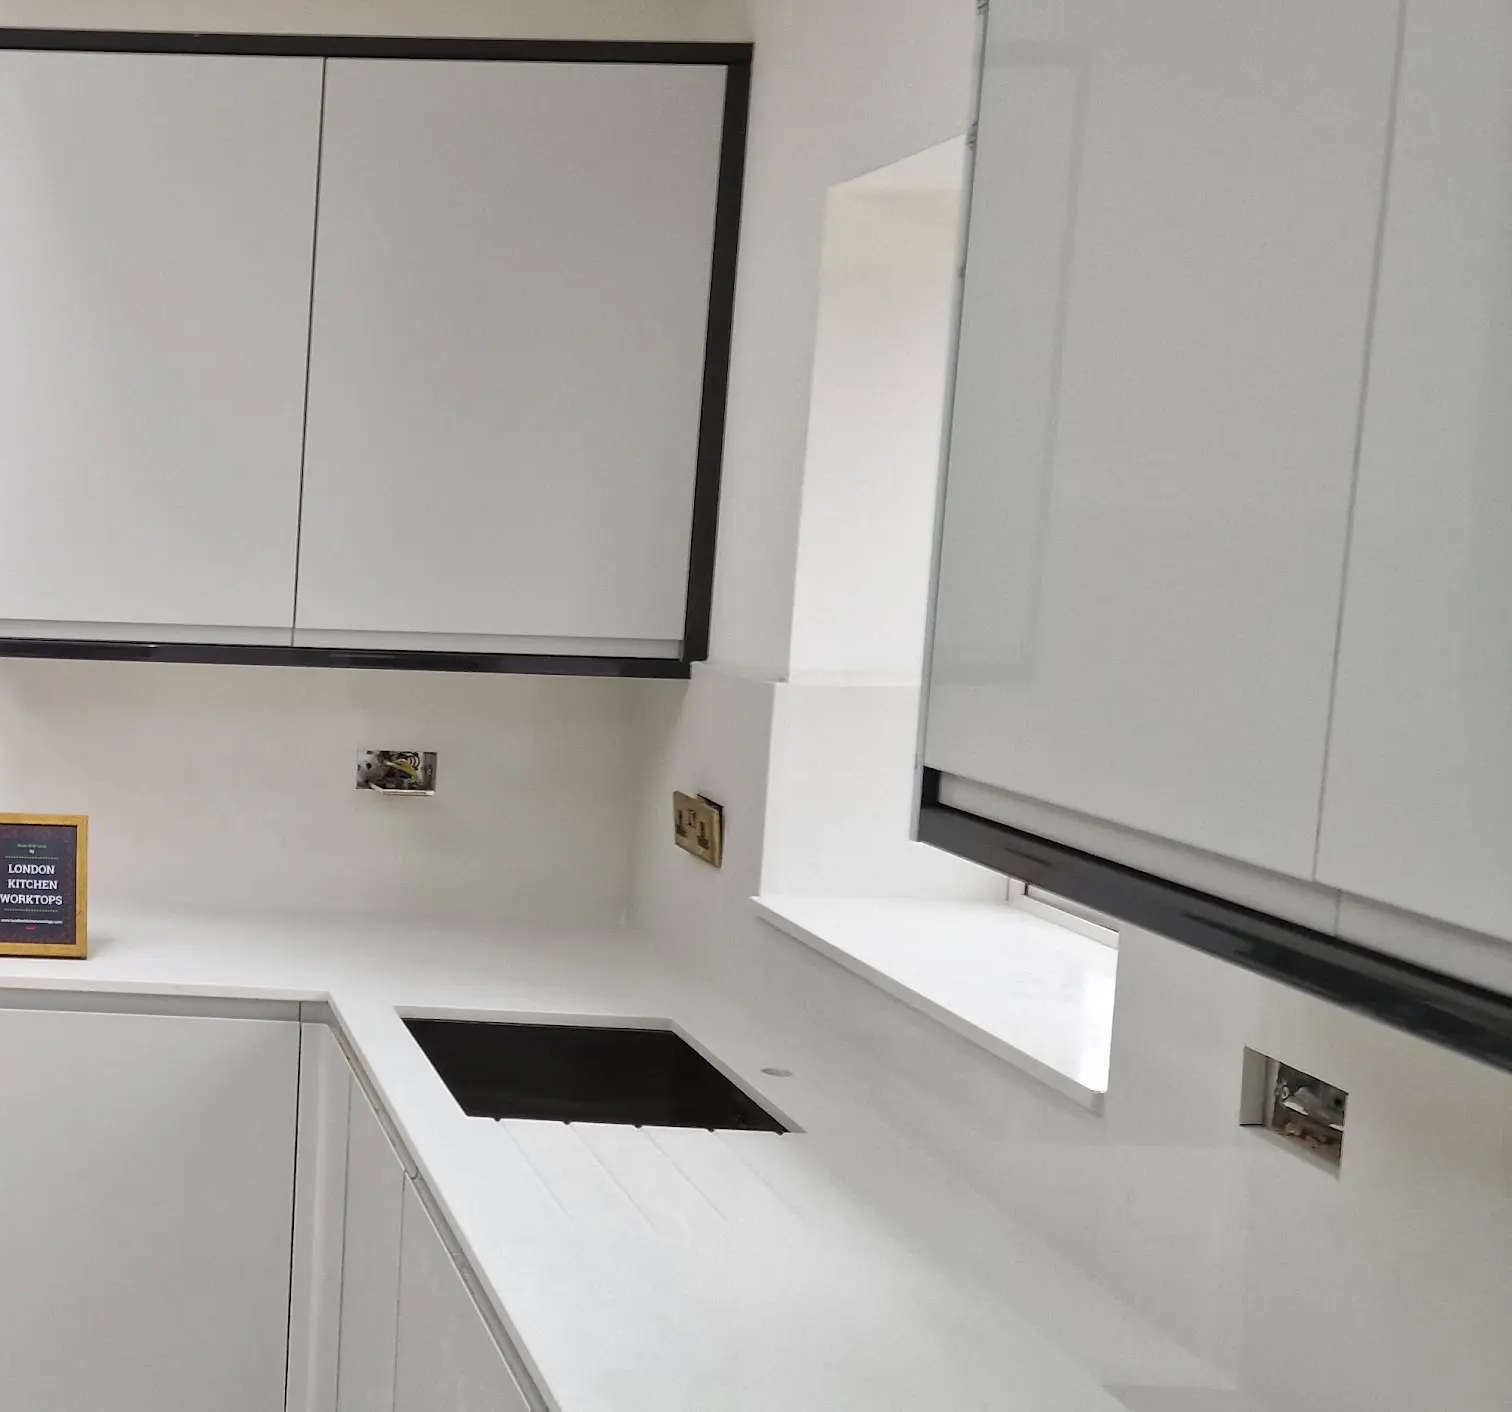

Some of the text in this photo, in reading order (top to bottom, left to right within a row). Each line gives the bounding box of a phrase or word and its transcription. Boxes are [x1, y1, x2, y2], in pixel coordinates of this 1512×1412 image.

[8, 864, 55, 875] LONDON
[7, 879, 58, 890] KITCHEN
[0, 893, 63, 906] WORKTOPS
